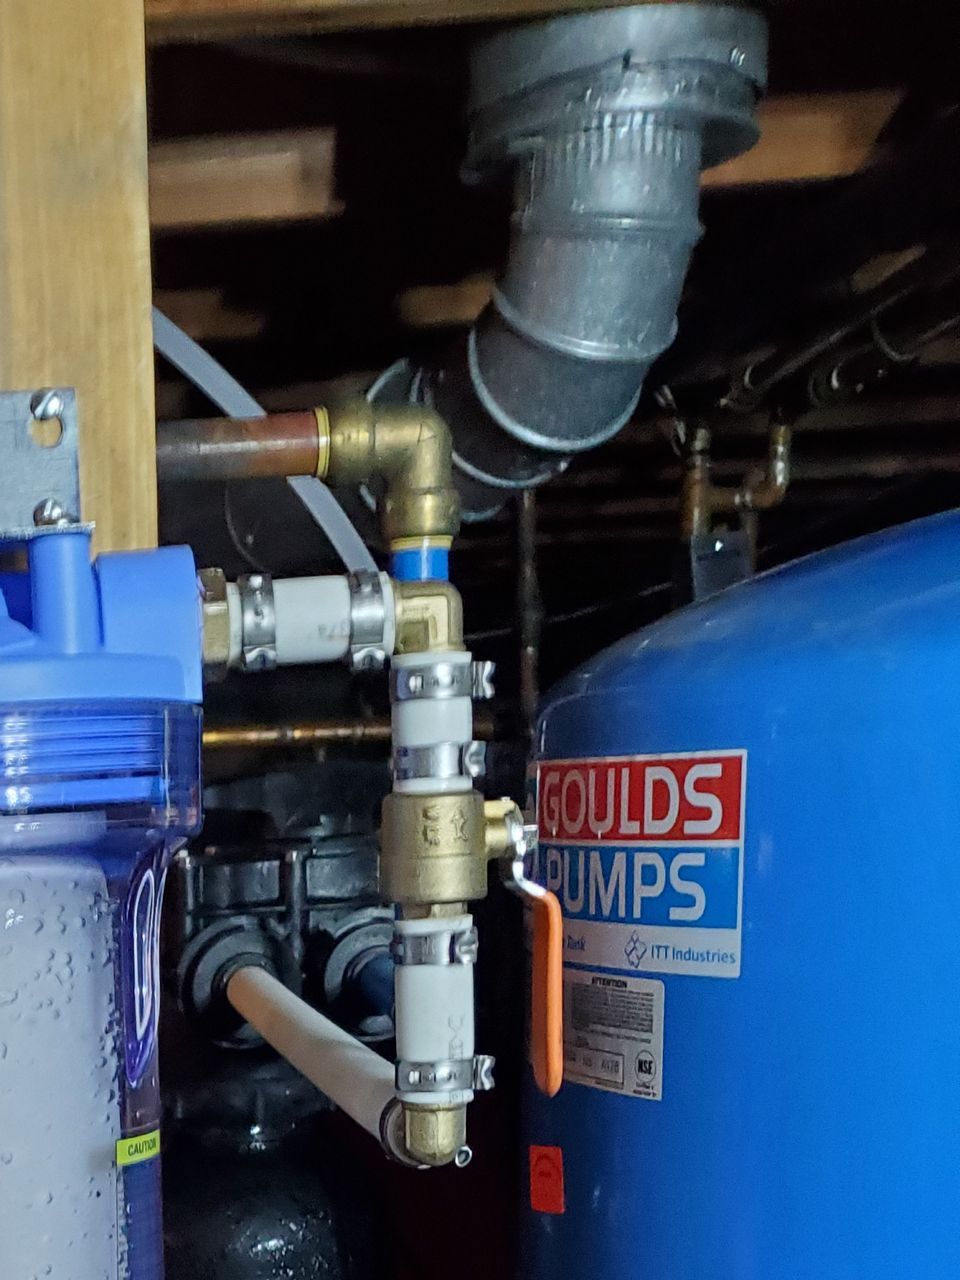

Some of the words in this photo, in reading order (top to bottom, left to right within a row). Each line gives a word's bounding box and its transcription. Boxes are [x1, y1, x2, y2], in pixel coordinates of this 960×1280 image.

[543, 763, 723, 835] GOULDS
[547, 849, 706, 921] PUMPS
[650, 944, 671, 960] ITT
[672, 946, 736, 965] Industries
[591, 976, 628, 989] ATTENTION
[128, 1138, 156, 1156] CAUTION
